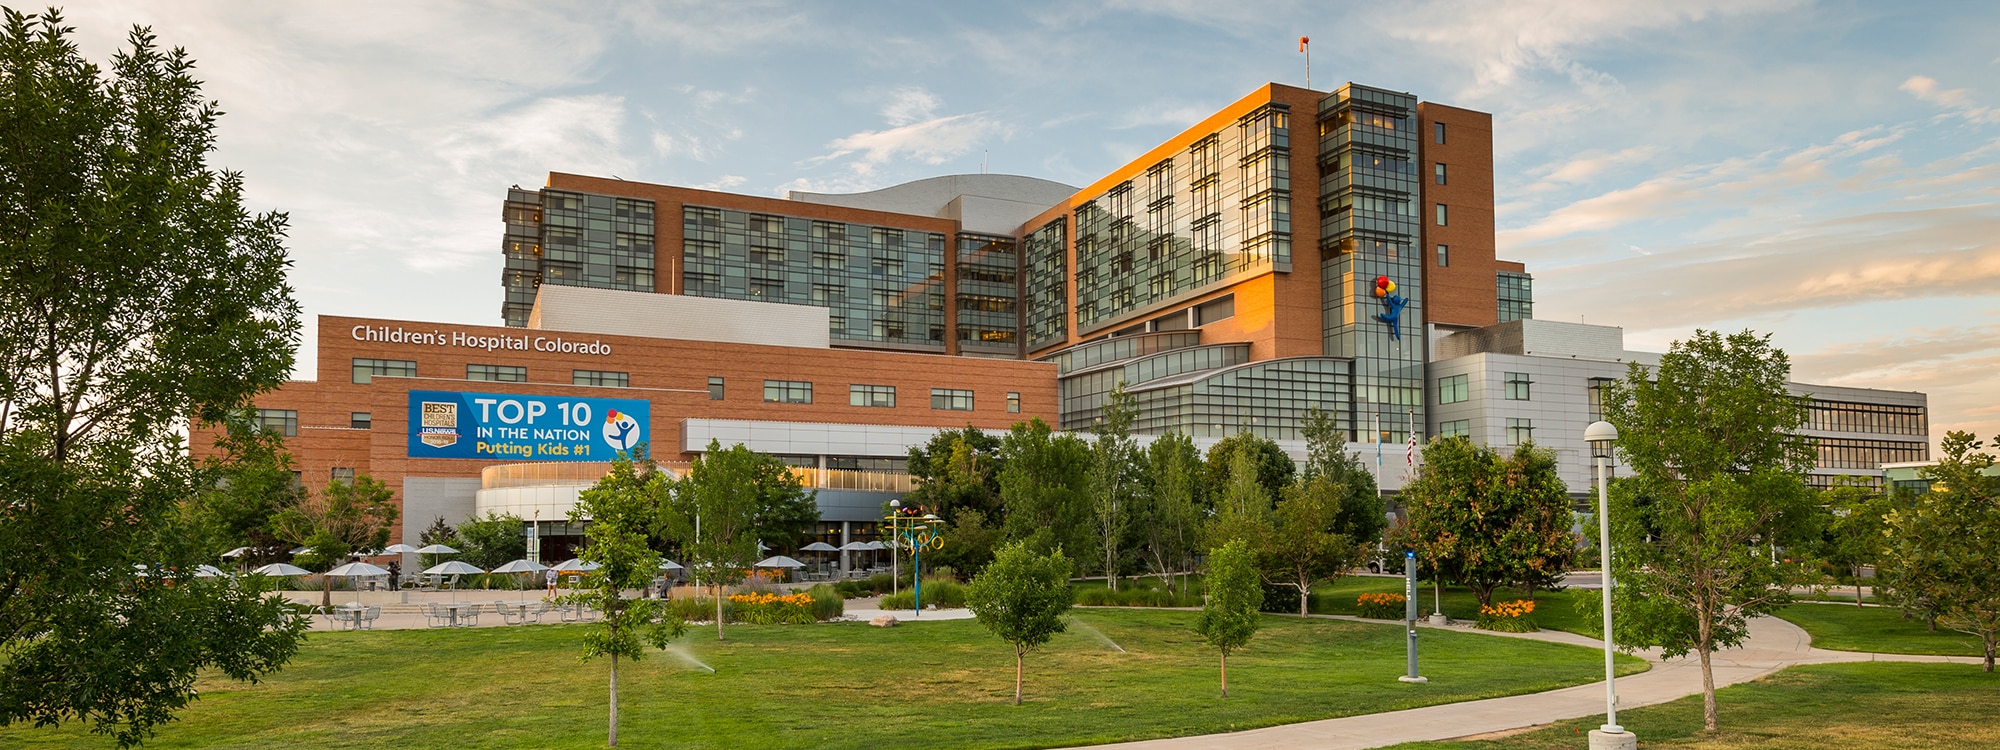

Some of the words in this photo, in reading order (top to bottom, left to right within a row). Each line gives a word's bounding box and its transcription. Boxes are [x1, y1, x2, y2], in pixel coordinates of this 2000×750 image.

[351, 325, 447, 346] Children's
[452, 331, 529, 352] Hospital
[533, 336, 611, 356] Colorado
[424, 403, 455, 413] BEST
[474, 398, 547, 425] TOP
[557, 402, 592, 427] 10
[476, 426, 493, 439] IN
[498, 427, 528, 440] THE
[533, 428, 591, 441] NATION
[476, 441, 533, 457] Putting
[537, 442, 569, 456] Kids
[573, 444, 590, 456] #1
